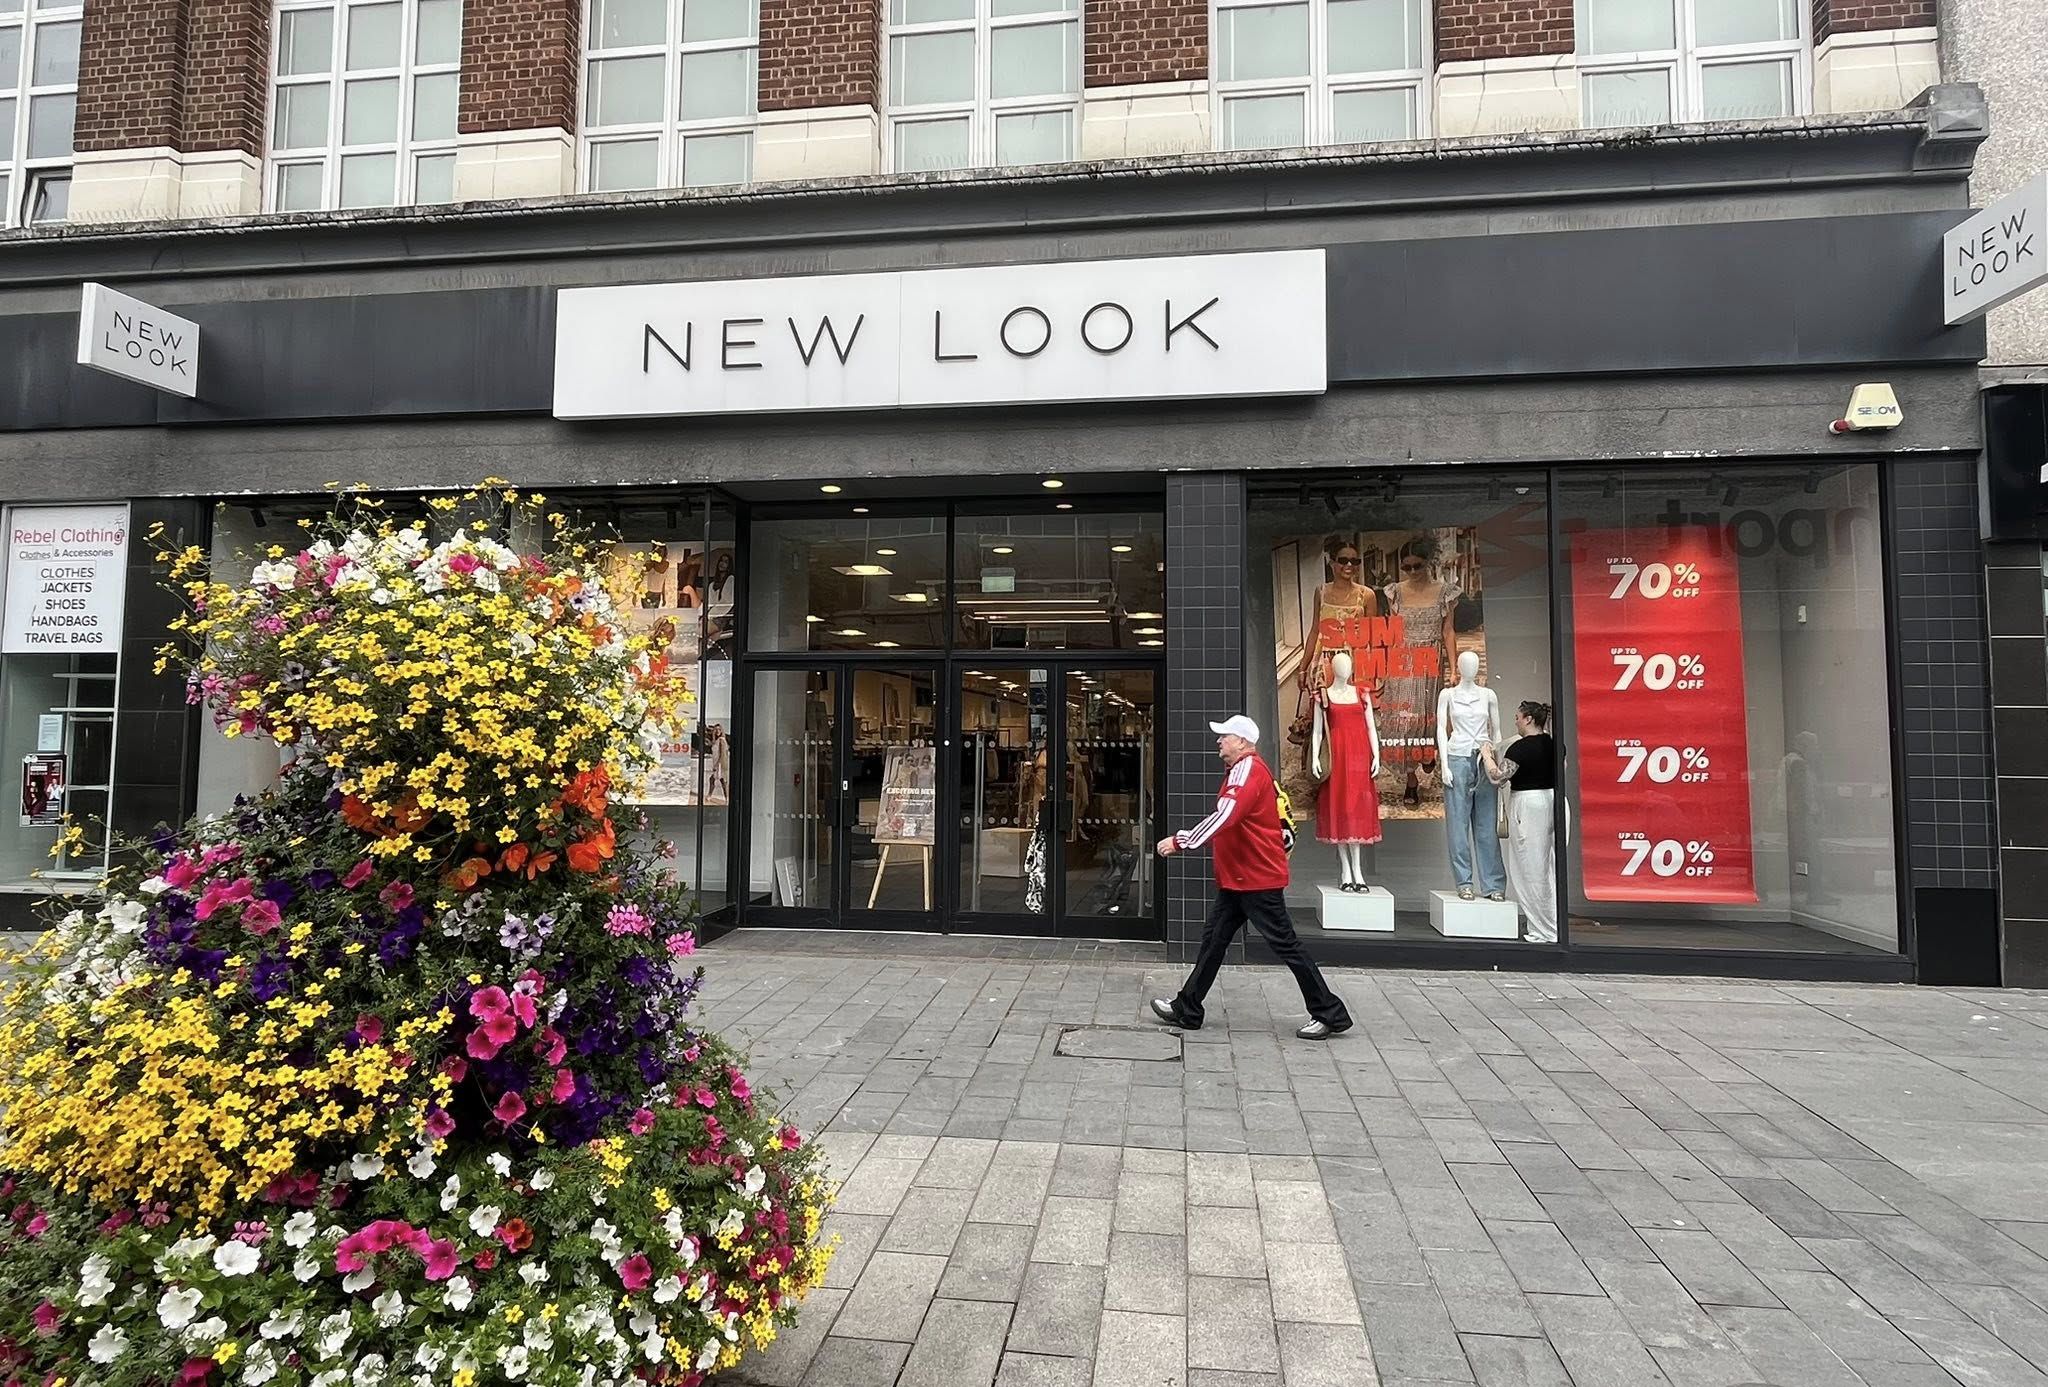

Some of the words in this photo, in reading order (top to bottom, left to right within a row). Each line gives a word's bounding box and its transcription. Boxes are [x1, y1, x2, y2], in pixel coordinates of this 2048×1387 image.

[1959, 208, 2027, 267] NEW
[1953, 233, 2034, 297] LOOK
[113, 311, 184, 352] NEW
[643, 314, 865, 373] NEW
[935, 297, 1220, 362] LOOK
[105, 332, 188, 376] LOOK
[1857, 405, 1897, 416] SECOM
[13, 528, 57, 544] Rebel
[61, 527, 125, 546] Clothing
[19, 550, 51, 561] Clothes
[54, 548, 60, 558] &
[62, 548, 114, 558] Accessories
[41, 567, 95, 579] CLOTHES
[1609, 562, 1700, 599] 70%
[40, 582, 92, 593] JACKETS
[1672, 587, 1700, 598] OFF
[45, 599, 86, 610] SHOES
[31, 615, 98, 627] HANDBAGS
[25, 632, 67, 644] TRAVEL
[71, 632, 103, 643] BAGS
[1610, 647, 1623, 655] UP
[1625, 647, 1638, 655] TO
[1613, 653, 1705, 691] 70%
[1676, 679, 1705, 690] OFF
[660, 743, 690, 753] 2.99
[1380, 738, 1406, 747] TOPS
[1407, 737, 1435, 746] FROM
[1614, 739, 1627, 747] UP
[1629, 739, 1642, 747] TO
[1617, 746, 1709, 783] 70%
[1681, 772, 1709, 783] OFF
[1618, 832, 1631, 840] UP
[1632, 832, 1645, 840] TO
[1620, 840, 1714, 877] 70%
[1685, 866, 1713, 877] OFF
